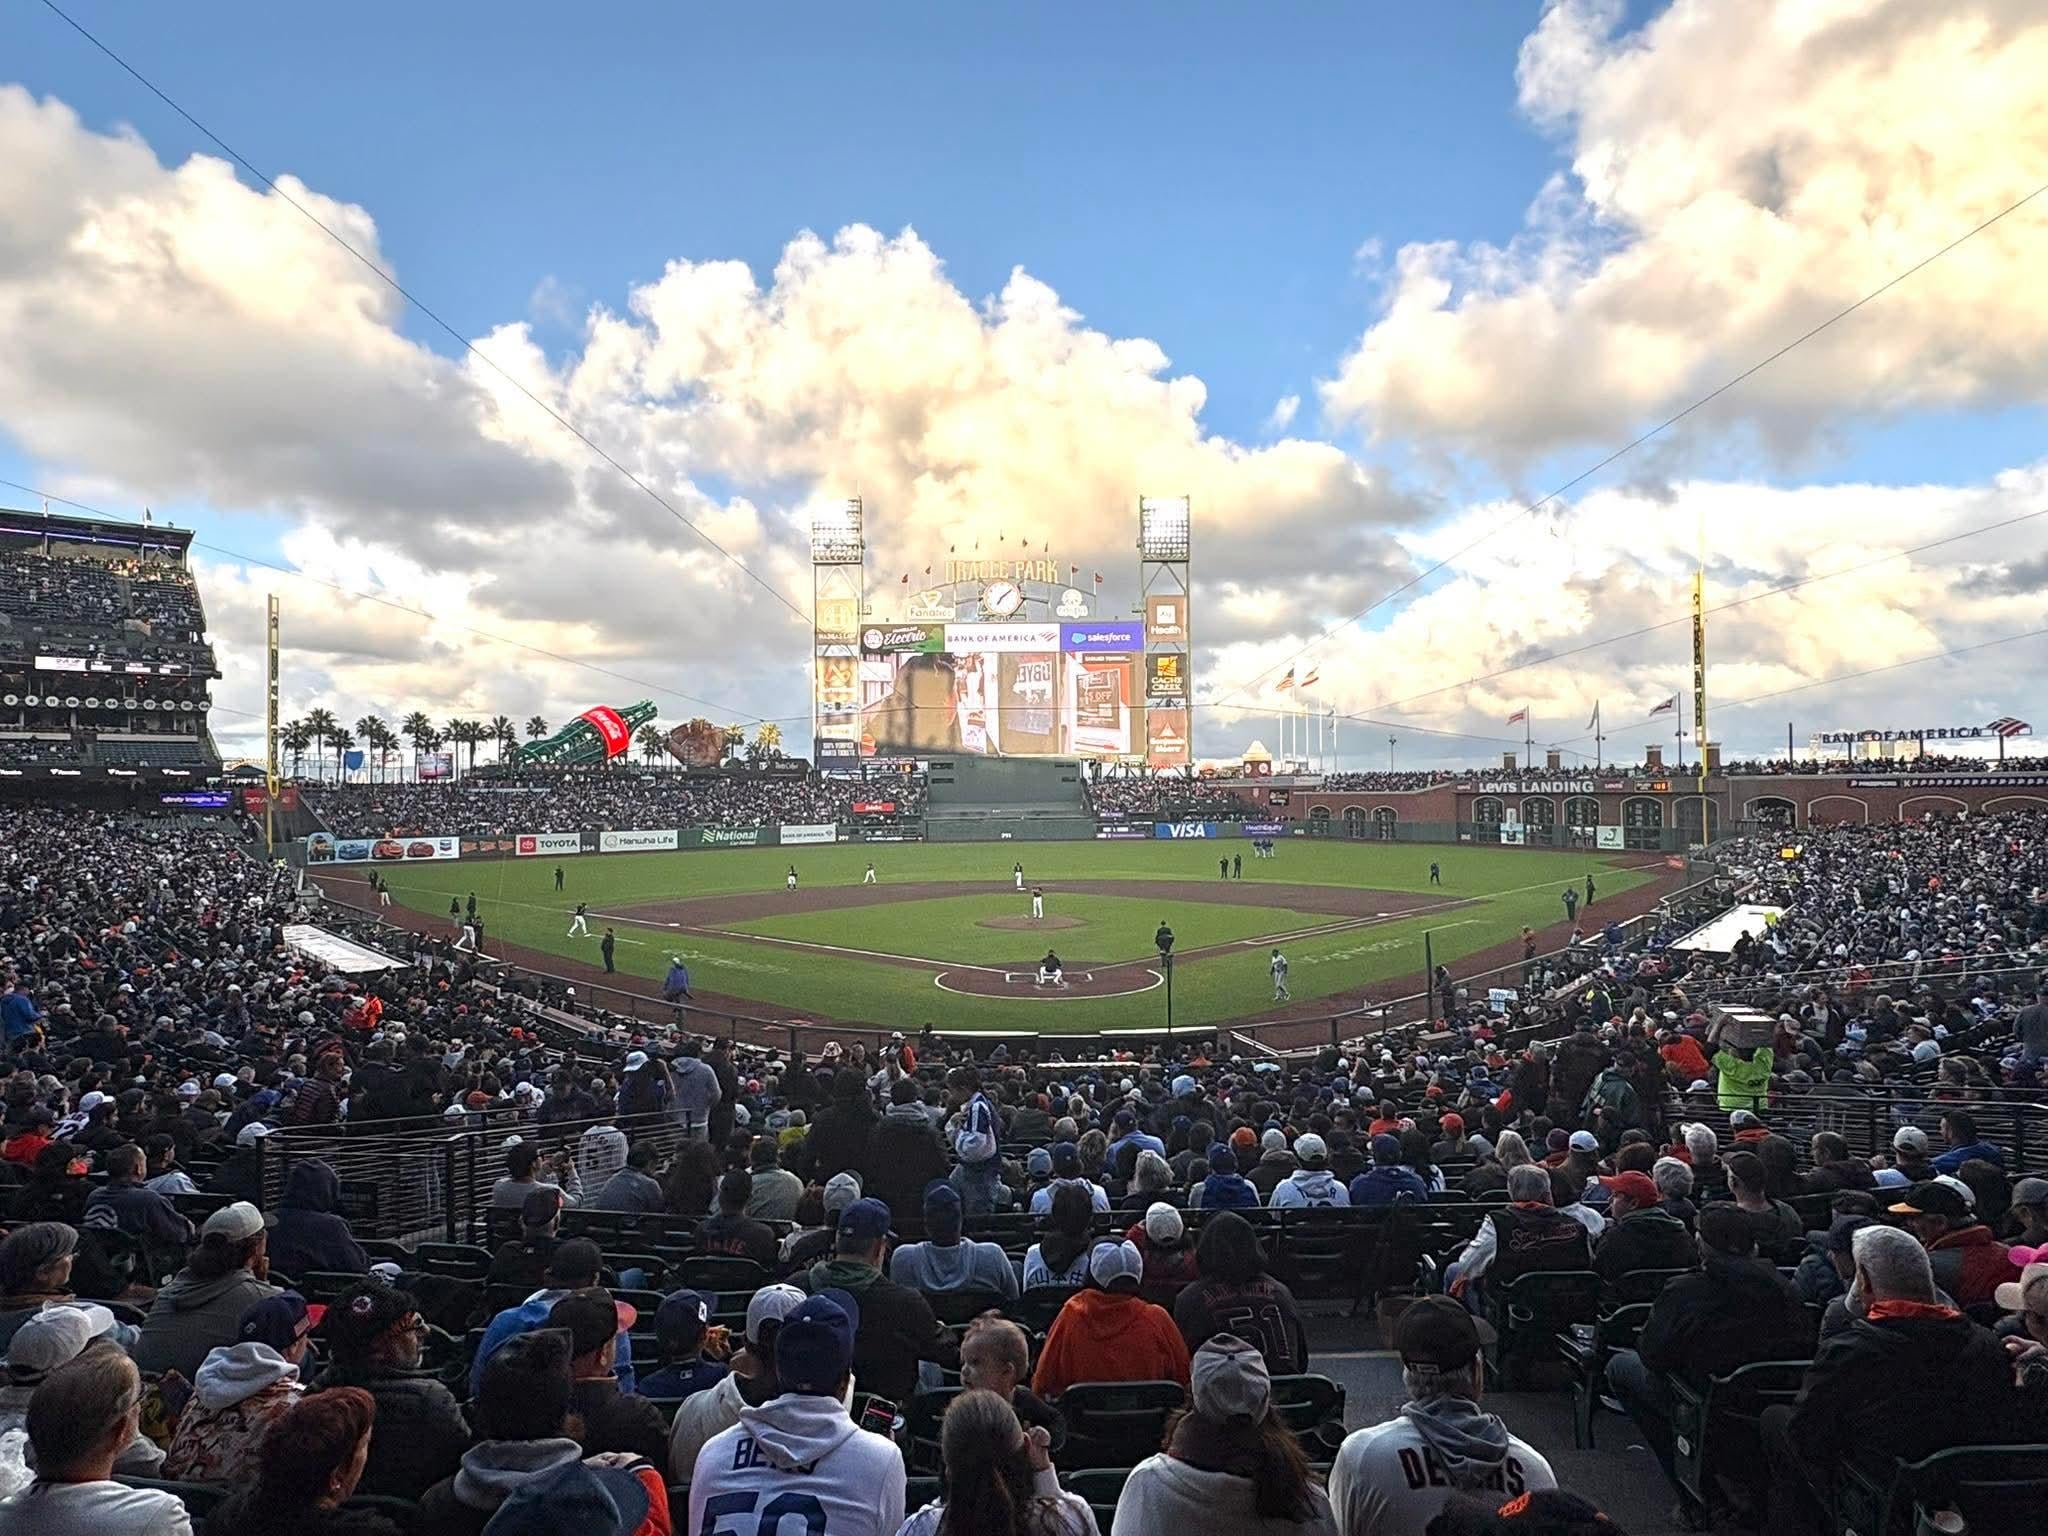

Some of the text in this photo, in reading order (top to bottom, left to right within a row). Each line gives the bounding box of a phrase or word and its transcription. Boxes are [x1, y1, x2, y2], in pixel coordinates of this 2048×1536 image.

[1015, 560, 1058, 583] PARK
[947, 633, 1037, 642] BANK OF AMERICA
[1087, 632, 1131, 643] salesforce
[1822, 727, 1982, 744] BANK OF AMERICA
[1521, 781, 1594, 793] LANDING
[715, 830, 758, 841] National
[1168, 823, 1205, 838] VISA
[539, 839, 578, 848] TOYOTA
[619, 835, 674, 845] Hanwha Life
